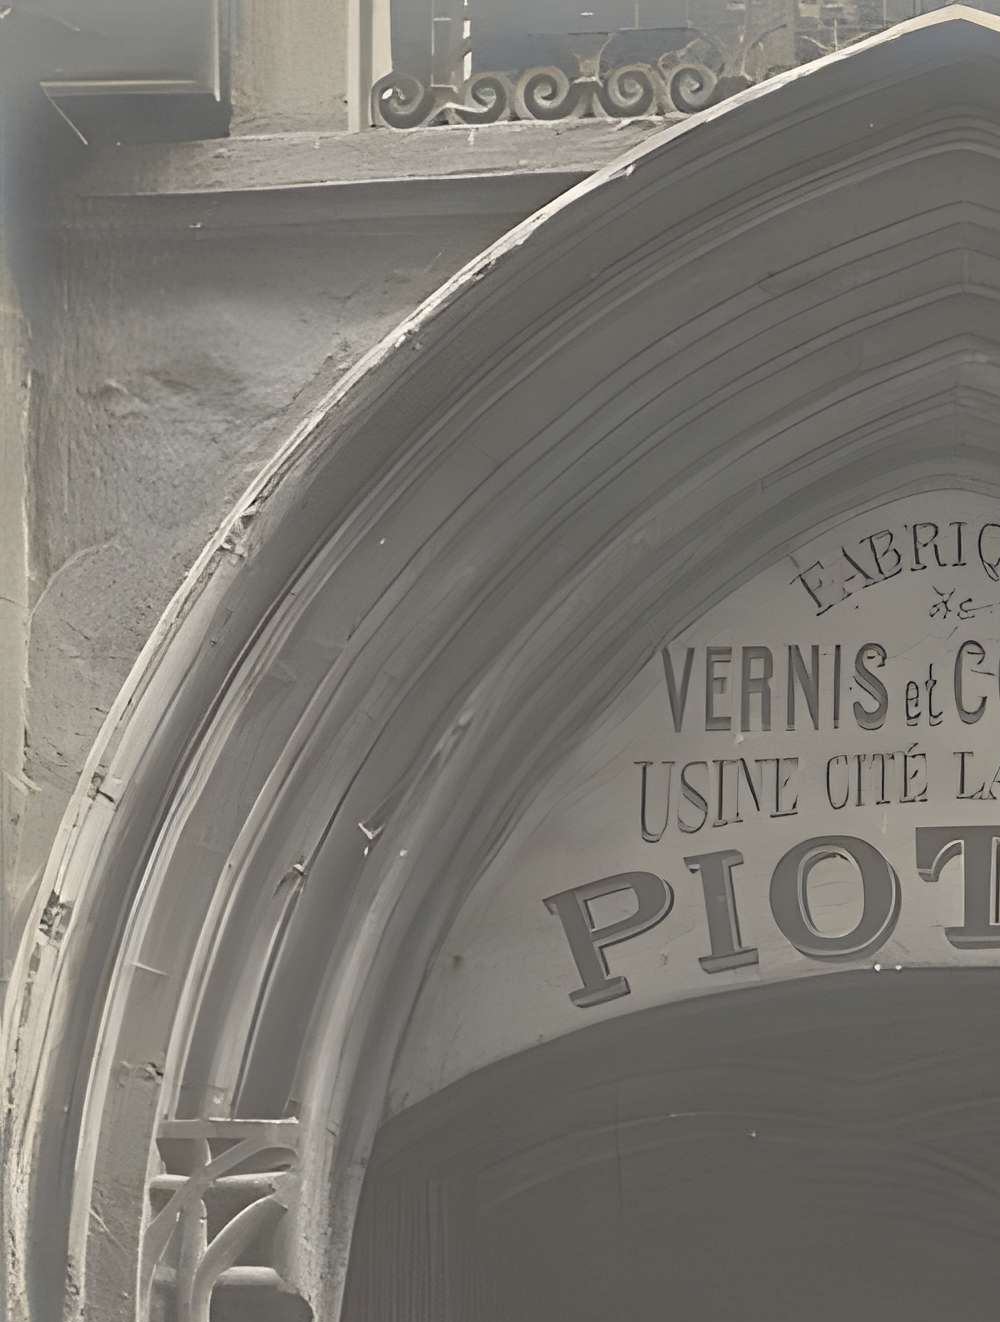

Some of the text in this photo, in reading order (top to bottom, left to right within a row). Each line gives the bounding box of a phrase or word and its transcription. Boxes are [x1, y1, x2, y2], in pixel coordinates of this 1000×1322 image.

[662, 642, 890, 733] VERNIS
[904, 664, 946, 727] et
[633, 755, 801, 844] USINE
